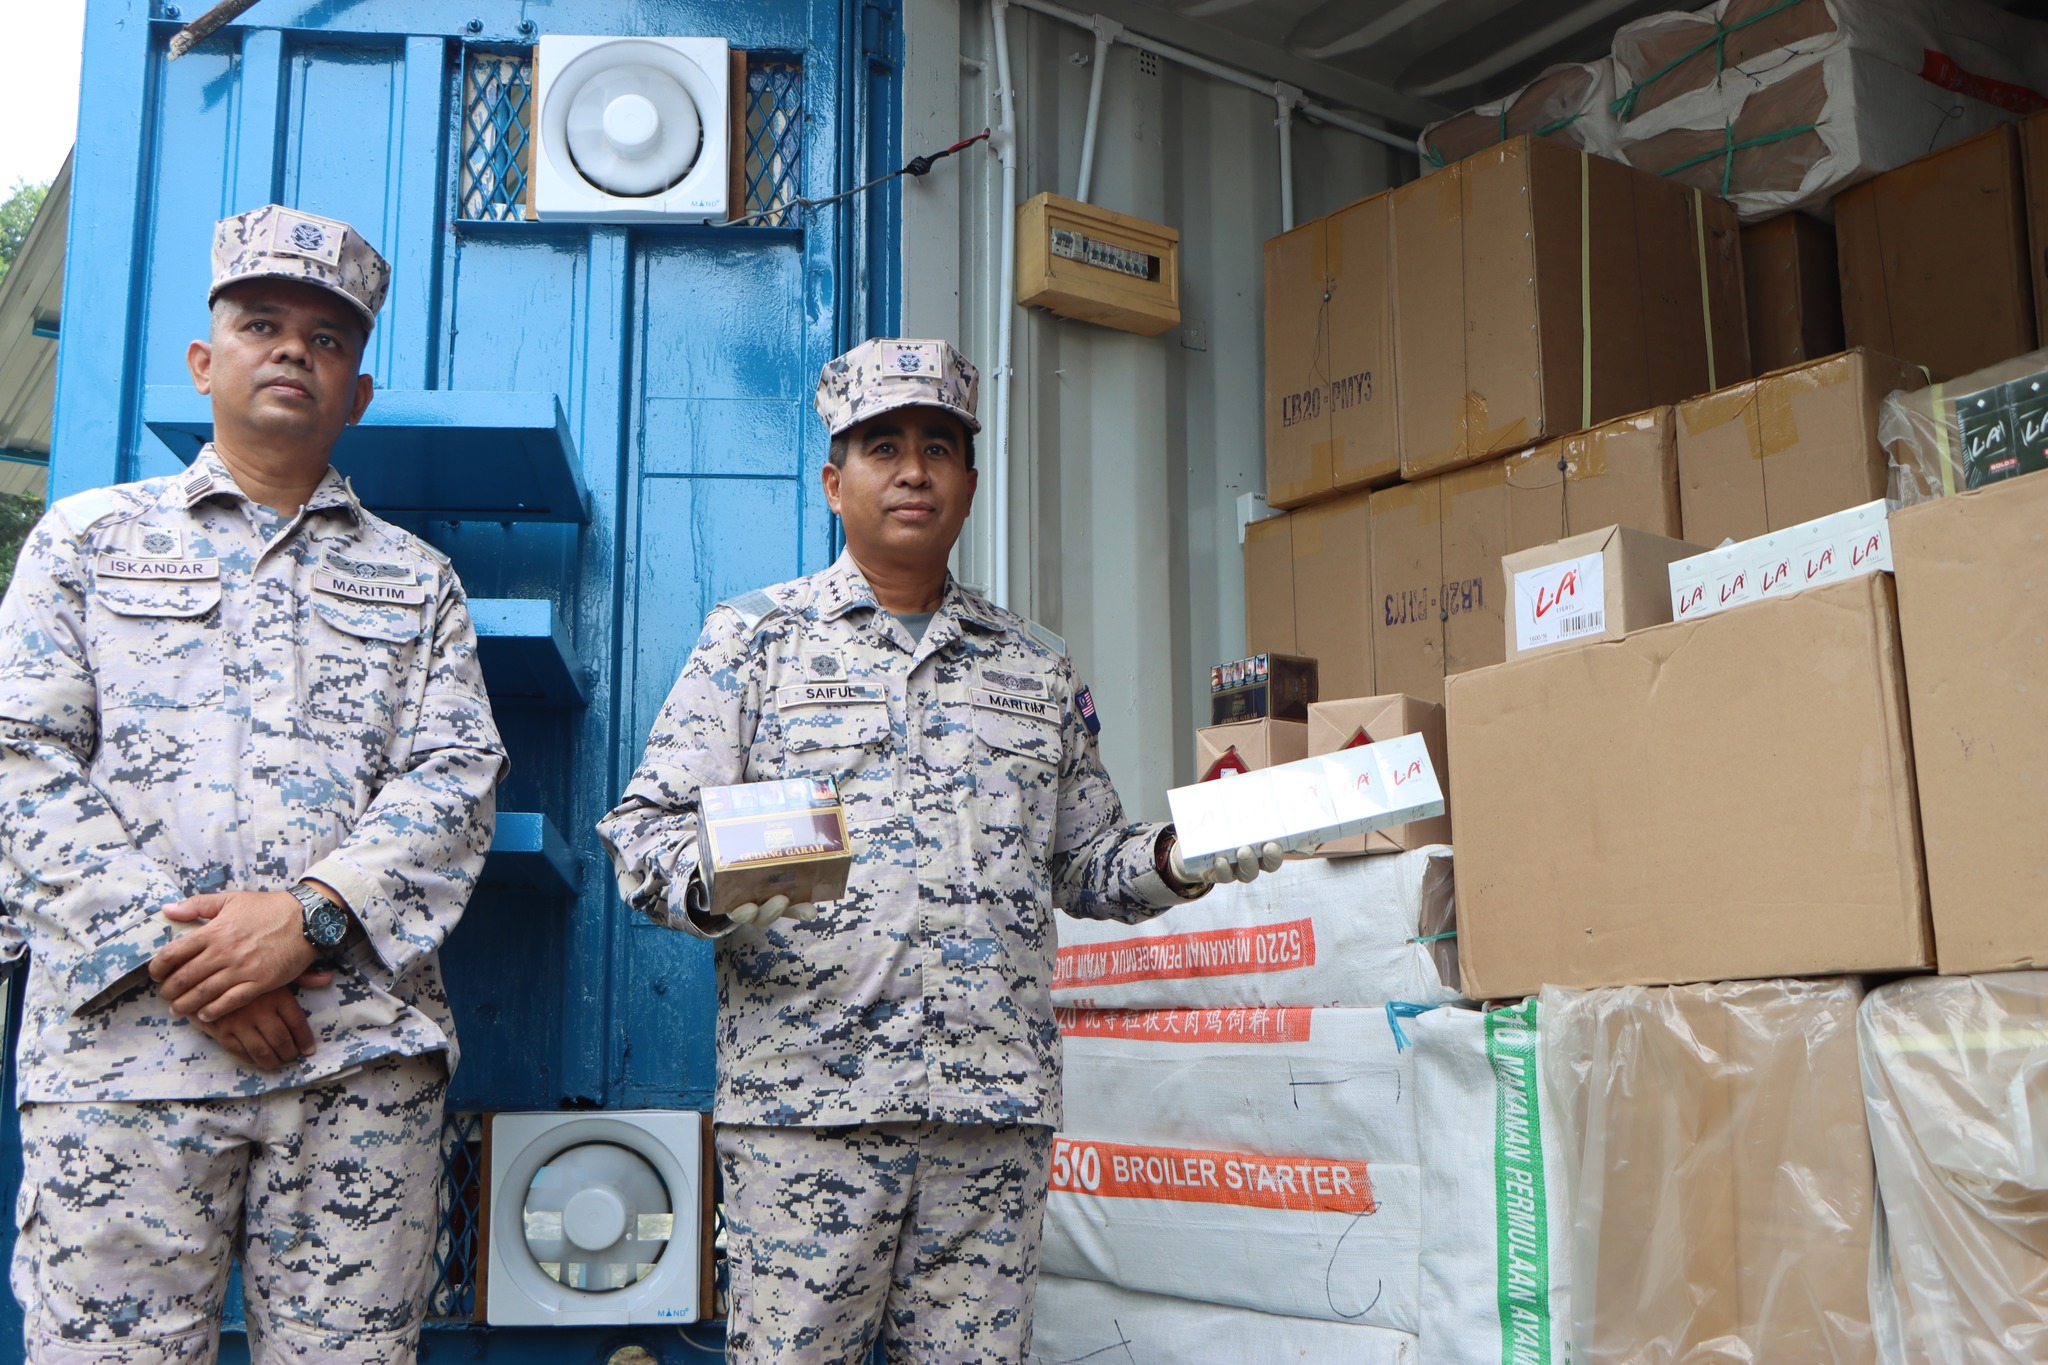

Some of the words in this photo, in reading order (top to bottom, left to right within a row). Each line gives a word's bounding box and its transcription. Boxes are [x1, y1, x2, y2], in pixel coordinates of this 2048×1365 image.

[110, 560, 204, 575] ISKANDAR
[332, 577, 405, 600] MARITIM
[806, 686, 857, 699] SAIFUL
[988, 694, 1046, 715] MARITIM
[740, 849, 783, 862] GUDANG
[786, 844, 825, 856] GARAM
[1111, 943, 1182, 975] PENGGEMUK
[1185, 937, 1250, 968] MAKANAN
[1255, 929, 1301, 964] 5220
[1077, 951, 1107, 979] AYAM
[1495, 1054, 1531, 1163] MAKANAN
[1112, 1155, 1220, 1187] BROILER
[1225, 1160, 1355, 1196] STARTER
[1505, 1166, 1537, 1304] PERMULAAN
